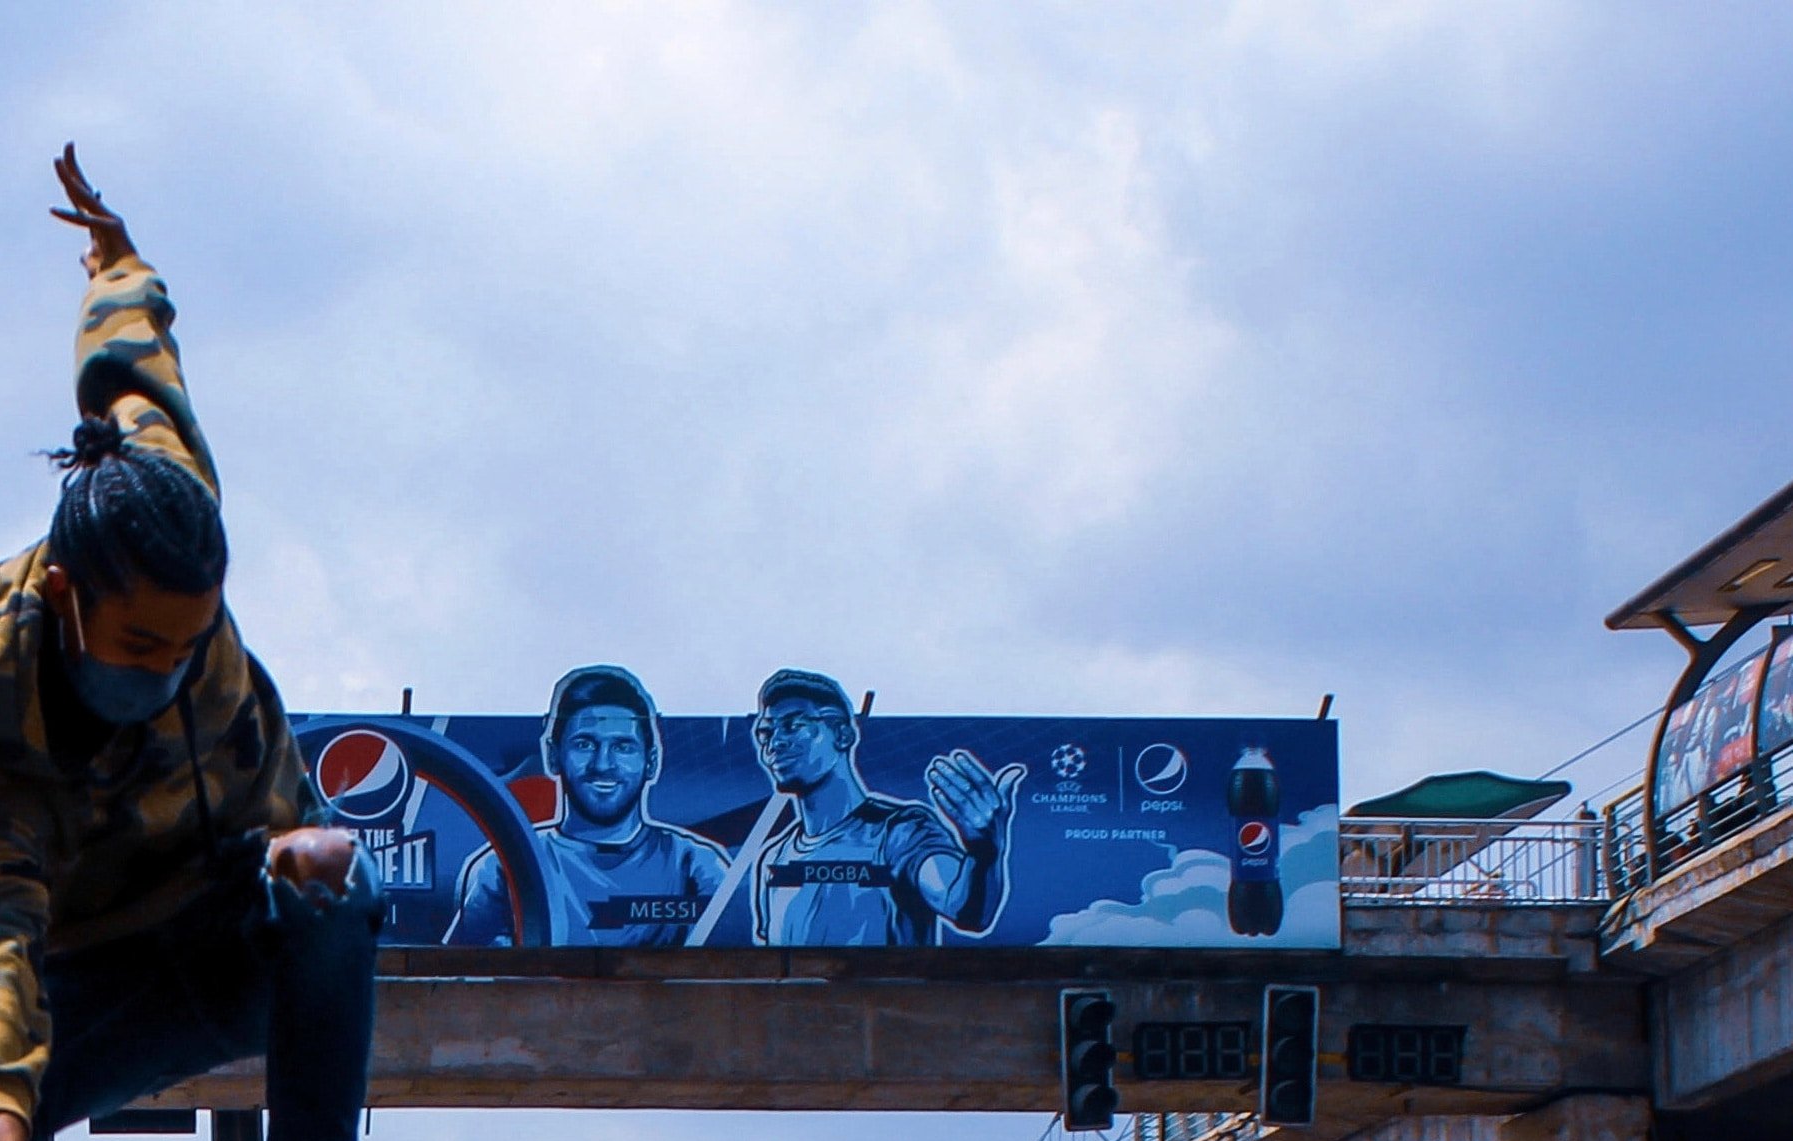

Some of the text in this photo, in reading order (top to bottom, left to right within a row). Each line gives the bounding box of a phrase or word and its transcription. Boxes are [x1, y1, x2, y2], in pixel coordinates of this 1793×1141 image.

[1031, 792, 1107, 804] CHAMPIONS
[1141, 800, 1183, 814] pepsi
[364, 828, 395, 849] THE
[1064, 828, 1166, 840] PROUD PARTNER
[403, 837, 427, 884] IT
[804, 865, 871, 882] POGBA
[630, 901, 697, 919] MESSI
